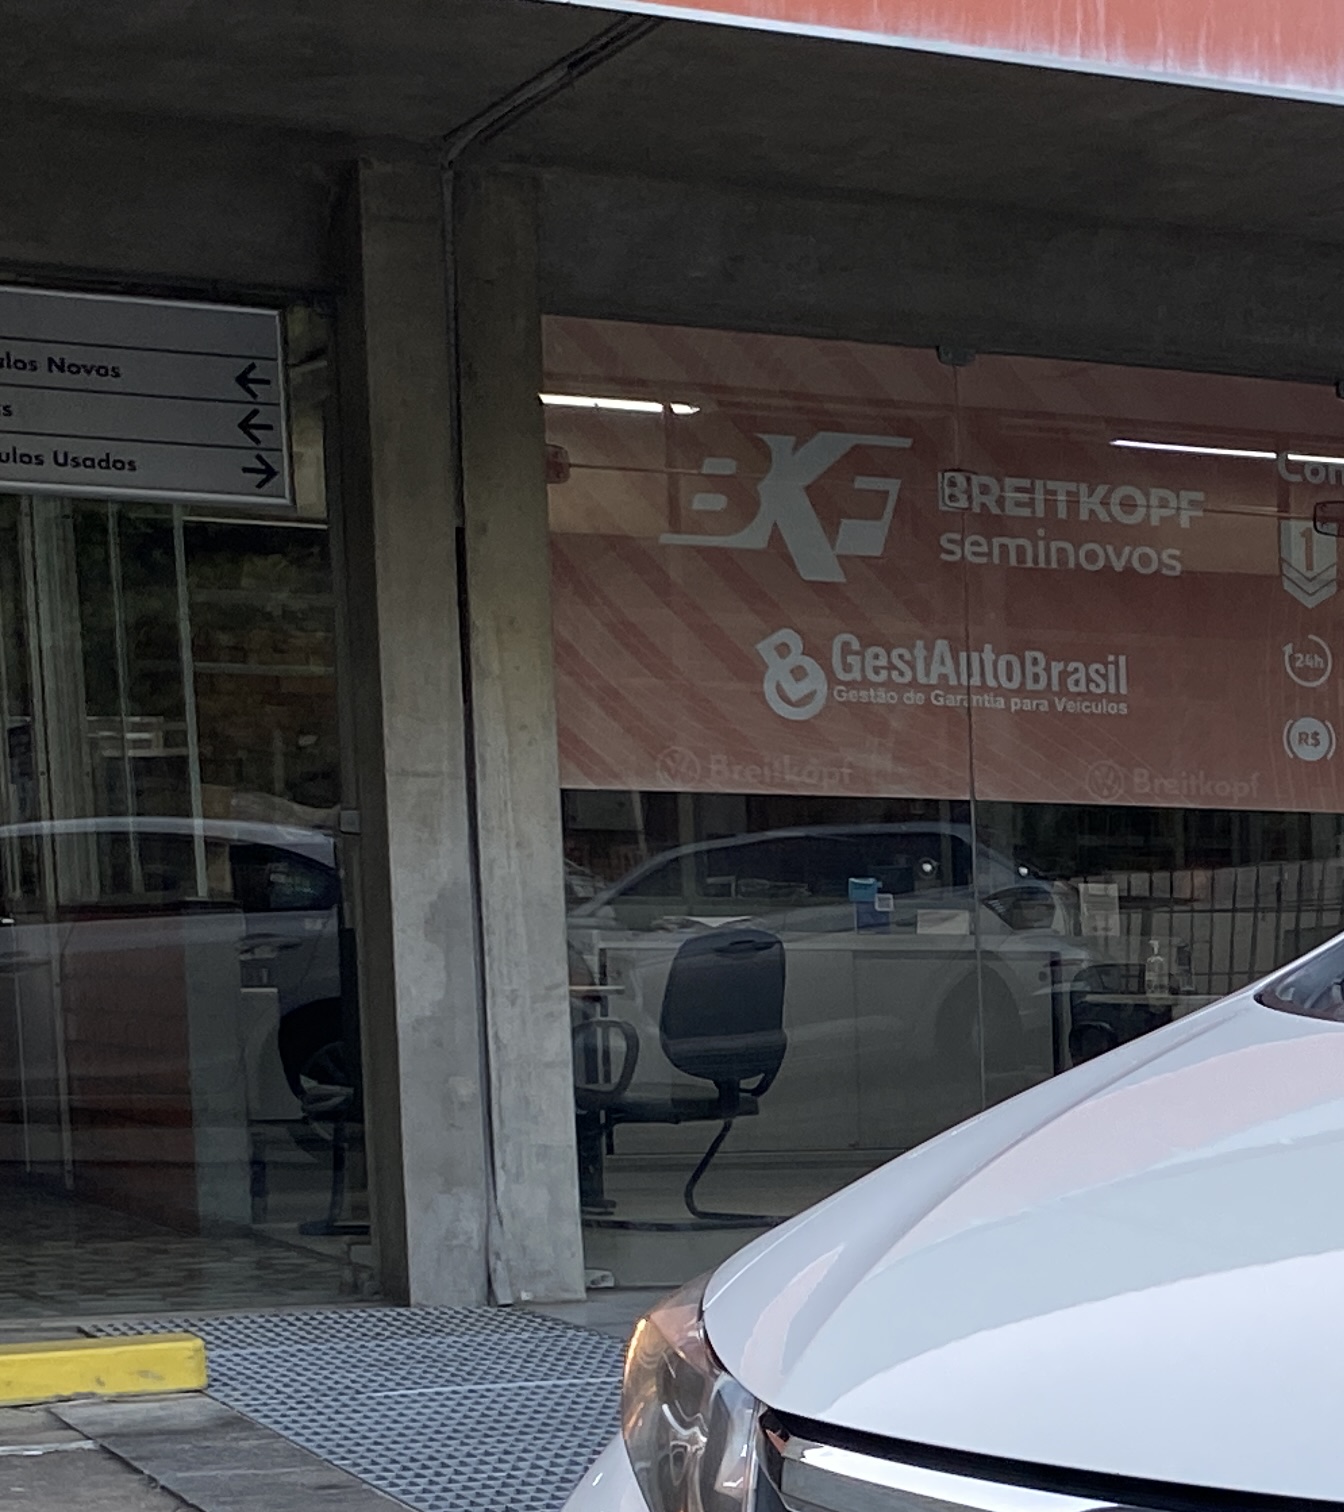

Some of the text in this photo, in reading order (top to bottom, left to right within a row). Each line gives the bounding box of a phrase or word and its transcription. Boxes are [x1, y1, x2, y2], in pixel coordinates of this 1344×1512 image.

[47, 357, 121, 378] Novos
[53, 450, 138, 472] Usados
[938, 472, 1205, 529] BREITKOPF
[939, 527, 1183, 577] seminovos
[832, 633, 1128, 695] GestAutoBrasil
[833, 685, 1128, 715] Gestão de Garantia para Veículos
[1297, 731, 1321, 748] R$
[1133, 767, 1261, 804] Breitkopf
